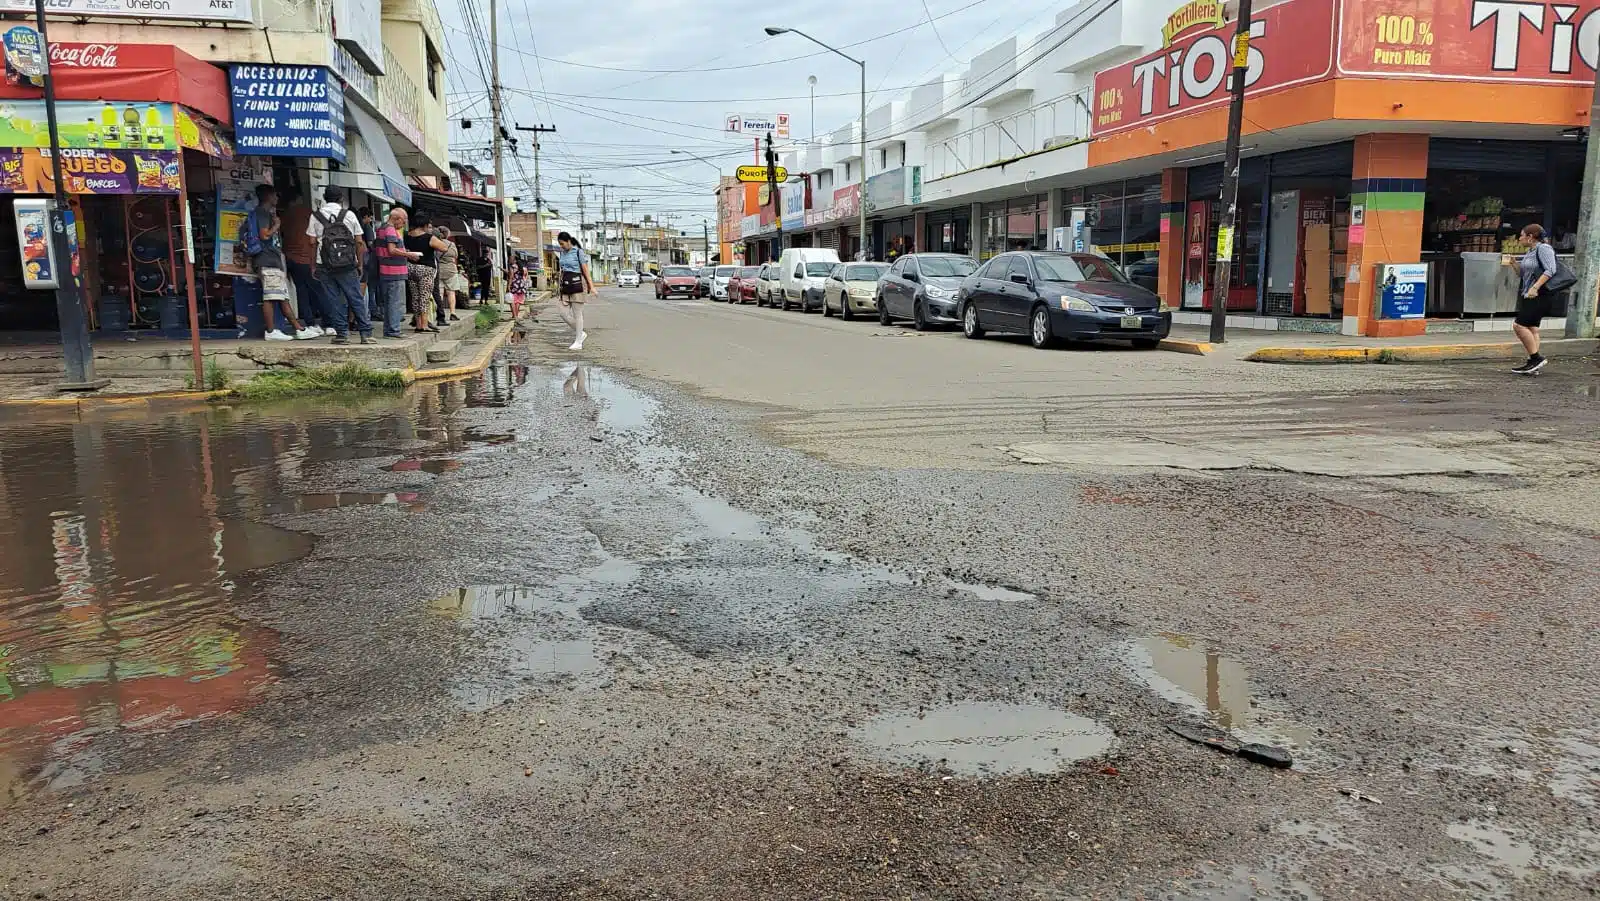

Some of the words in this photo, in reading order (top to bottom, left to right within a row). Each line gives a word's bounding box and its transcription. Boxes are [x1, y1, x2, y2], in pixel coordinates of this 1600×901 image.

[1376, 16, 1415, 45] 100
[1419, 22, 1434, 45] %
[1374, 48, 1402, 64] Puro
[236, 66, 318, 80] ACCESORIOS
[248, 83, 326, 97] CELULARES
[1100, 88, 1116, 110] 100
[244, 100, 280, 111] FUNDAS
[243, 117, 276, 128] MICAS
[289, 119, 313, 129] MANOS
[744, 121, 776, 129] Teresita
[292, 137, 332, 149] BOCINAS
[230, 168, 254, 180] ciel
[86, 179, 120, 189] BARCEL
[1303, 210, 1325, 219] BIEN
[1393, 284, 1414, 294] 300
